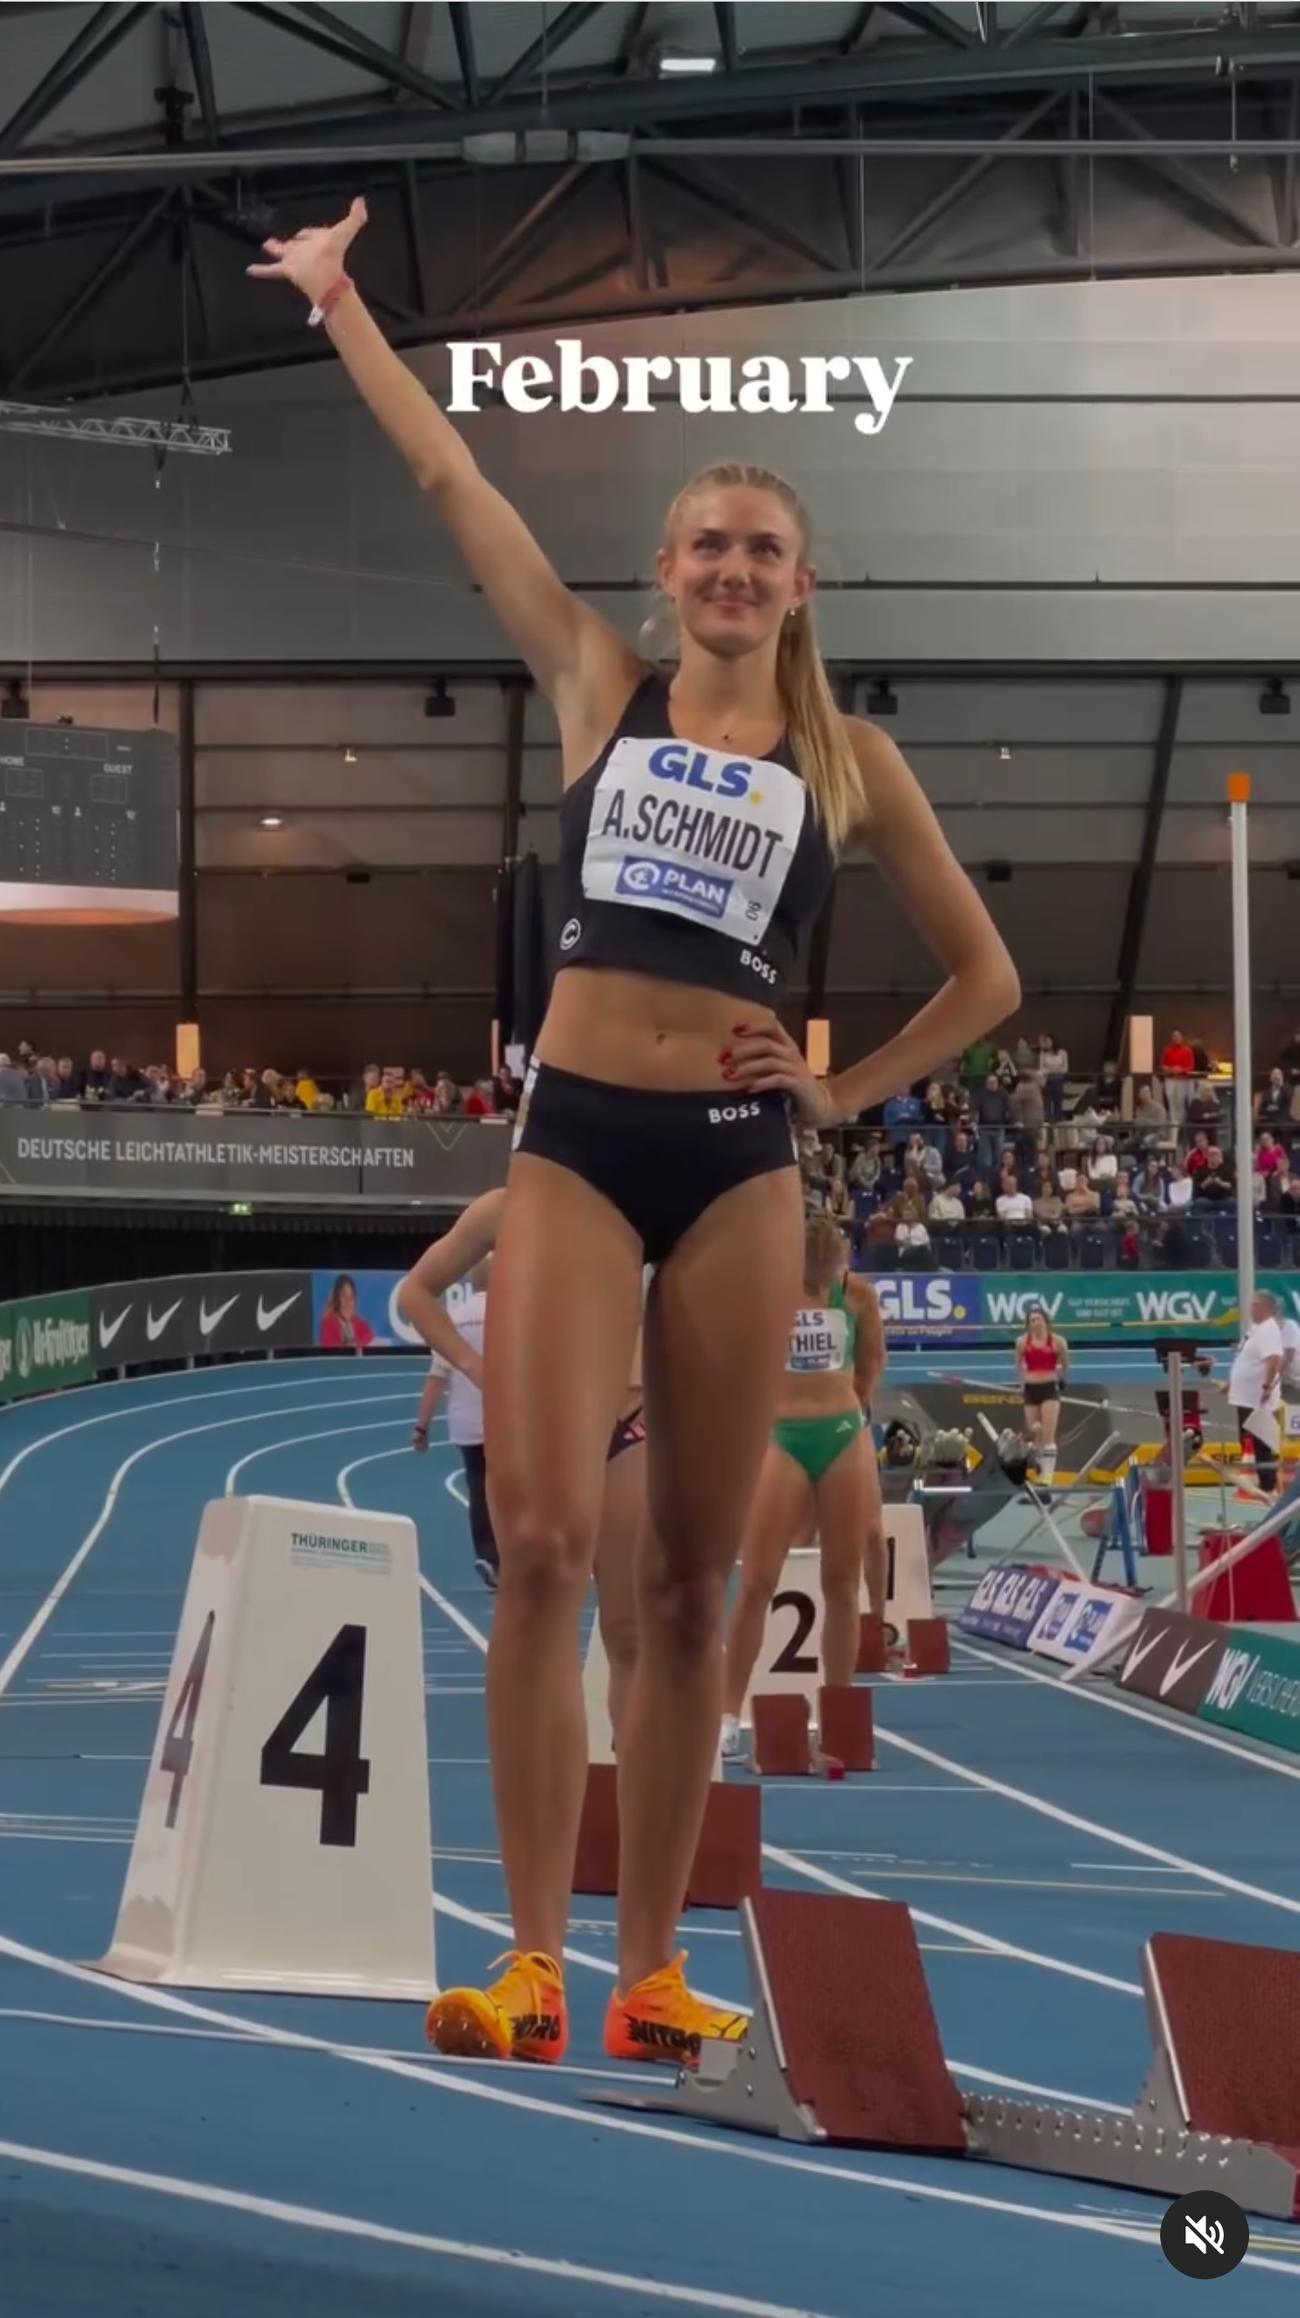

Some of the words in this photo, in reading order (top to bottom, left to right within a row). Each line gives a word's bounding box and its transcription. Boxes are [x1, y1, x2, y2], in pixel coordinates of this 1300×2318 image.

[103, 763, 133, 775] GUEST
[601, 789, 783, 878] A.SCHMIDT
[662, 868, 726, 904] PLAN
[739, 948, 778, 985] BOSS
[707, 1101, 761, 1124] BOSS
[17, 1137, 111, 1161] DEUTSCHE
[116, 1140, 415, 1168] LEICHTATHLETIK-MEISTERSCHAFTEN
[986, 1291, 1064, 1323] WGV
[1136, 1290, 1217, 1321] WGV
[290, 1532, 369, 1554] THÜRINGER
[769, 1590, 819, 1673] 2
[160, 1610, 215, 1829] 4
[260, 1624, 370, 1848] 4
